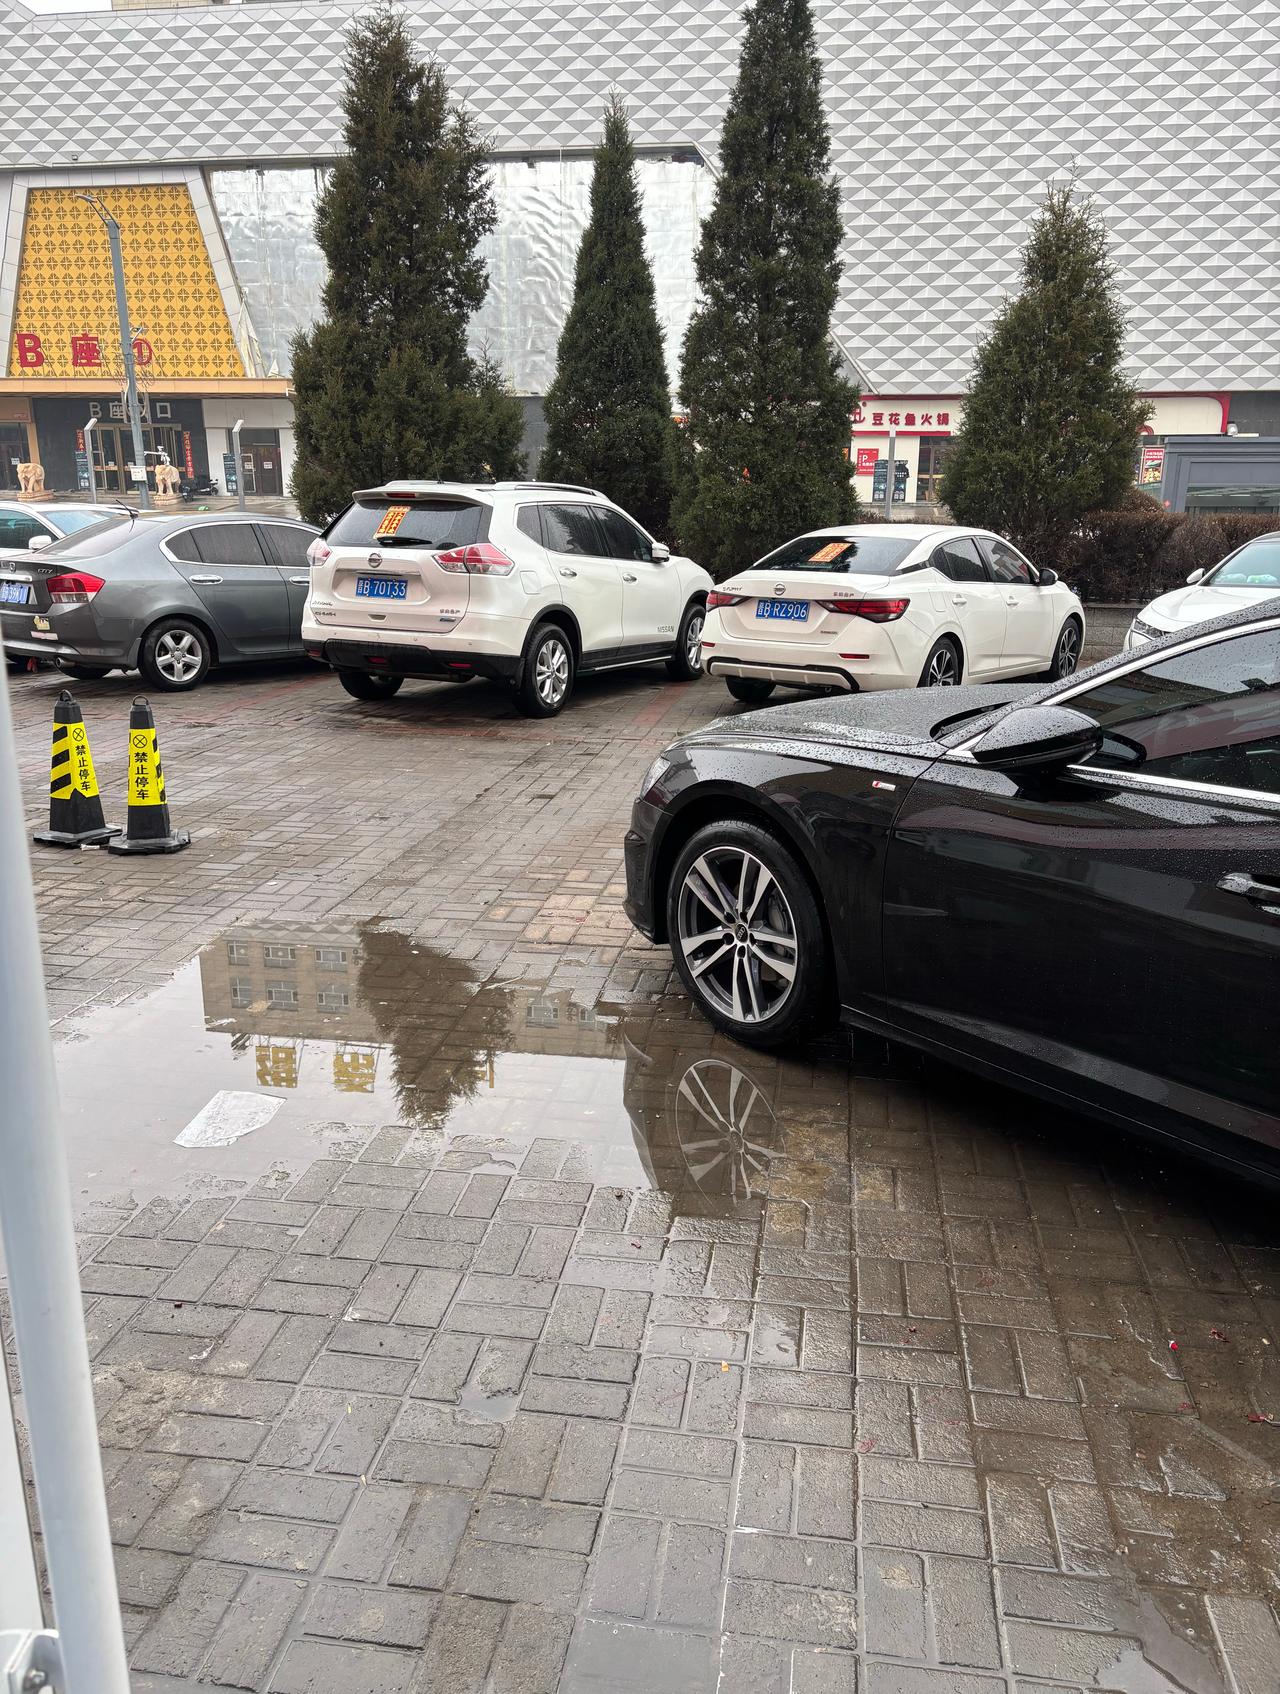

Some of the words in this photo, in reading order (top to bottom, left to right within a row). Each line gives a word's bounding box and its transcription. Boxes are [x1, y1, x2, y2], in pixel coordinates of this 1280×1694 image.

[89, 401, 172, 419] B座口
[872, 412, 950, 426] 豆花鱼火锅
[75, 744, 91, 792] 禁止停车
[134, 751, 150, 800] 禁止停车
